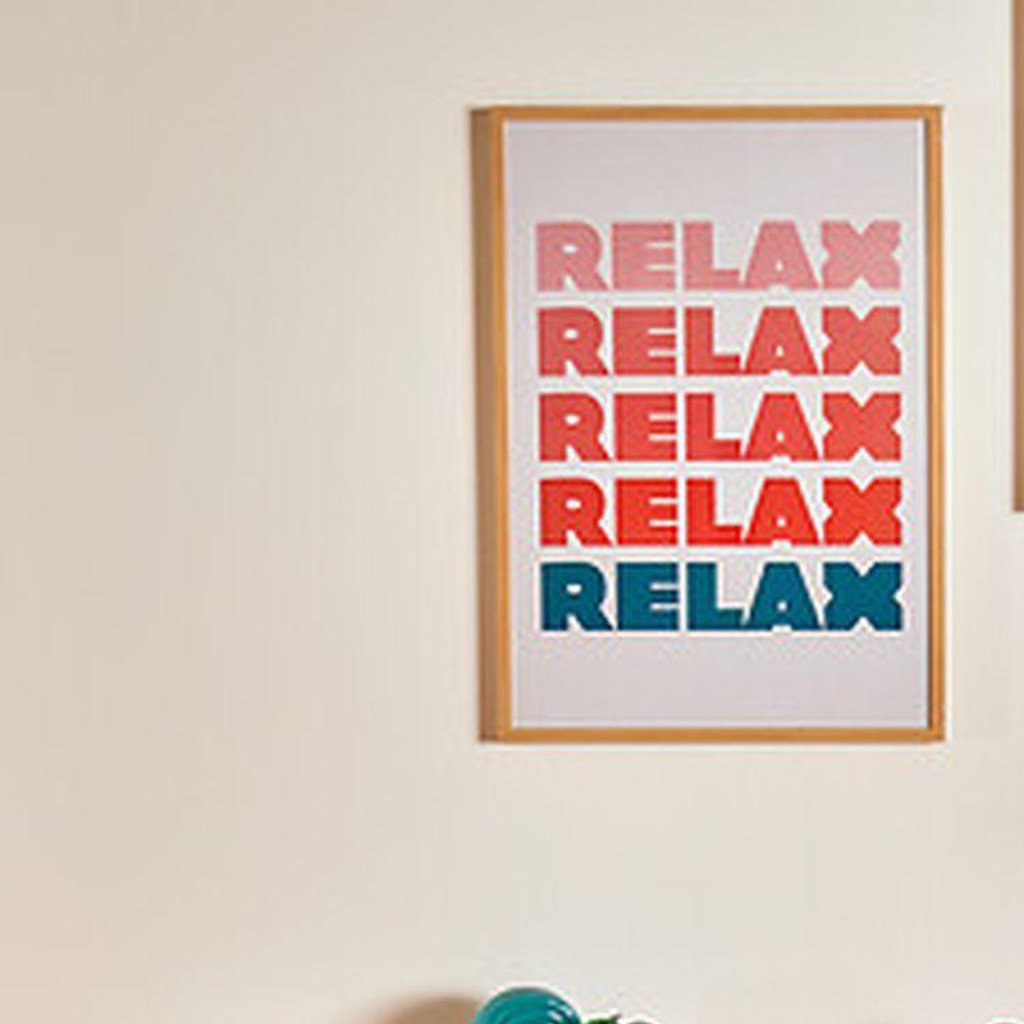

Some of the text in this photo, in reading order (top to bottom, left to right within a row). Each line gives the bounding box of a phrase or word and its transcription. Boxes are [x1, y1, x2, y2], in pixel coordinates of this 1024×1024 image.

[535, 220, 901, 291] RELAX
[538, 307, 901, 376] RELAX
[539, 393, 901, 461] RELAX
[539, 478, 902, 546] RELAX
[540, 562, 904, 631] RELAX
